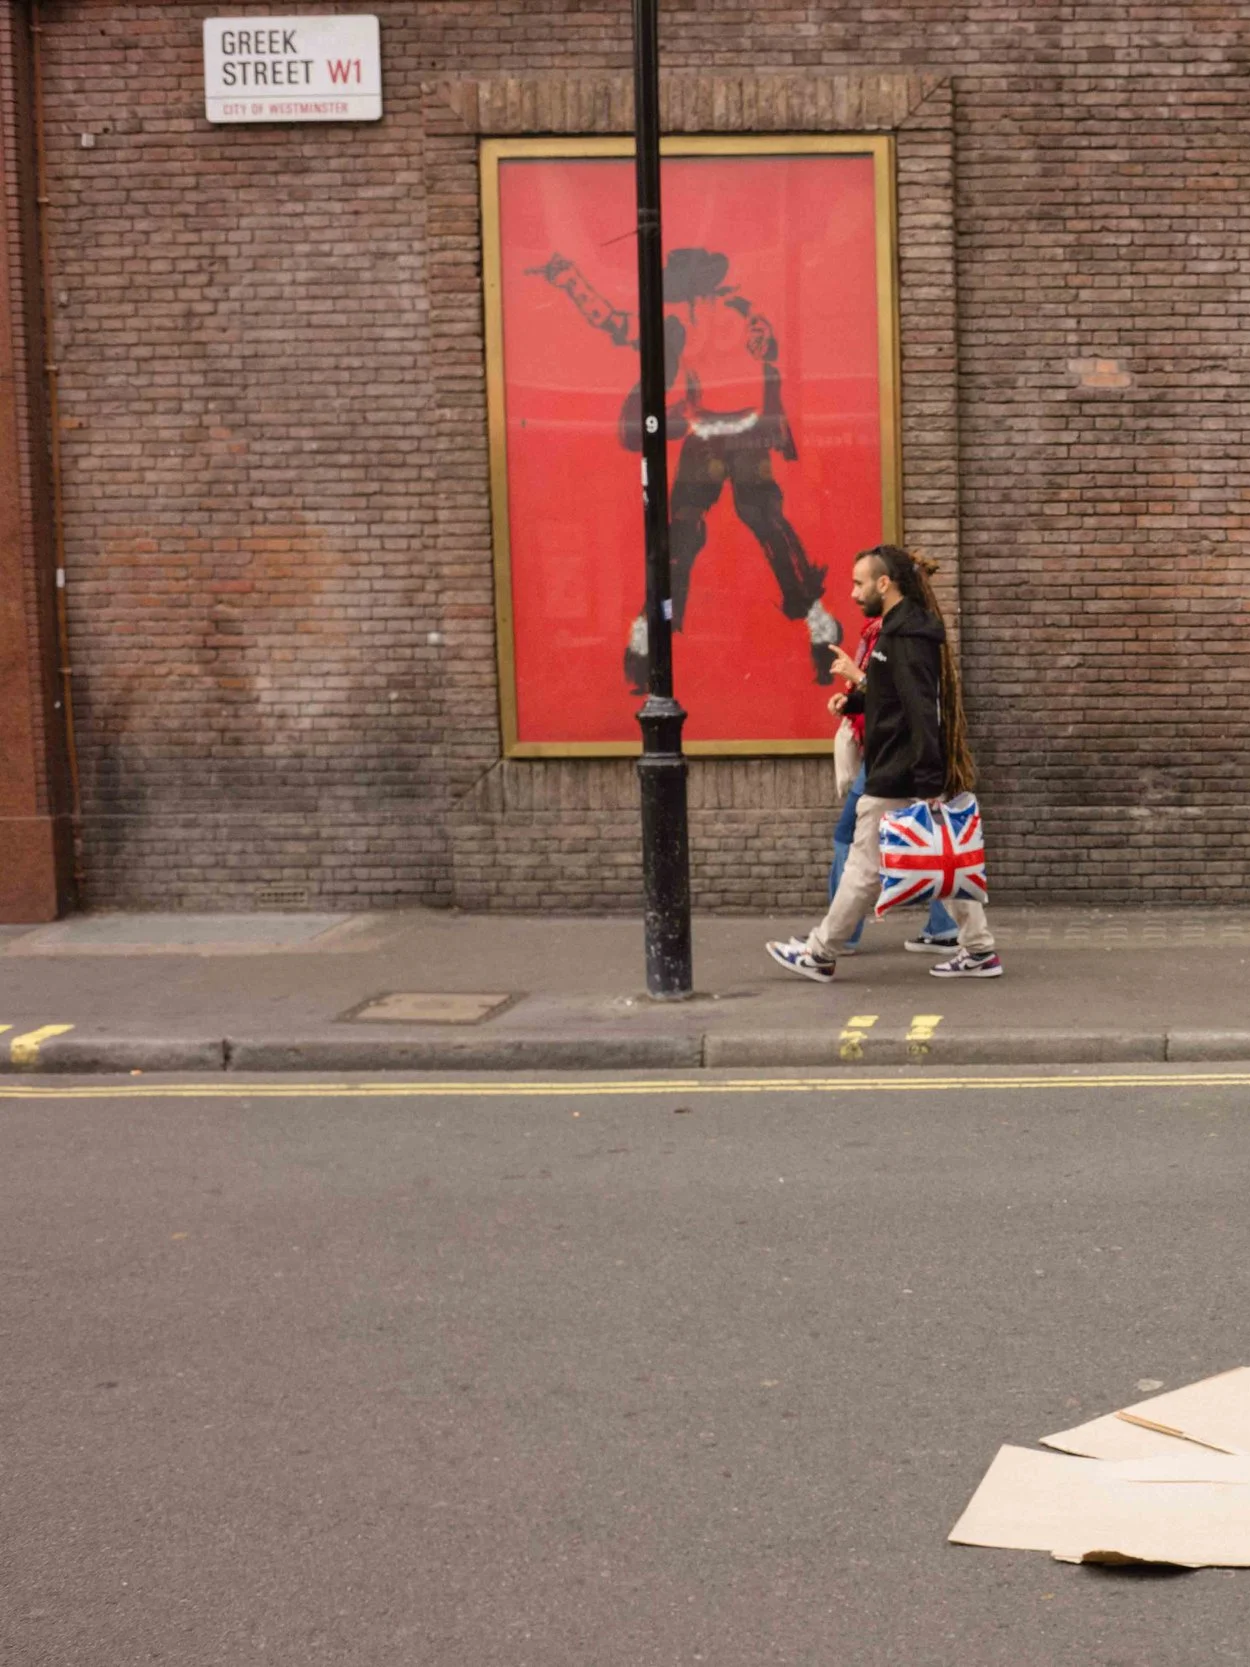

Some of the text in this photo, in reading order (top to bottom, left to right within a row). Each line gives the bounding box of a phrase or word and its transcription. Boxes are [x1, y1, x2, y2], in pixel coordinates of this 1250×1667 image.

[222, 30, 298, 55] GREEK
[223, 58, 362, 86] STREET W1
[223, 102, 349, 115] CITY OF WESTMINSTER
[645, 415, 658, 433] 9
